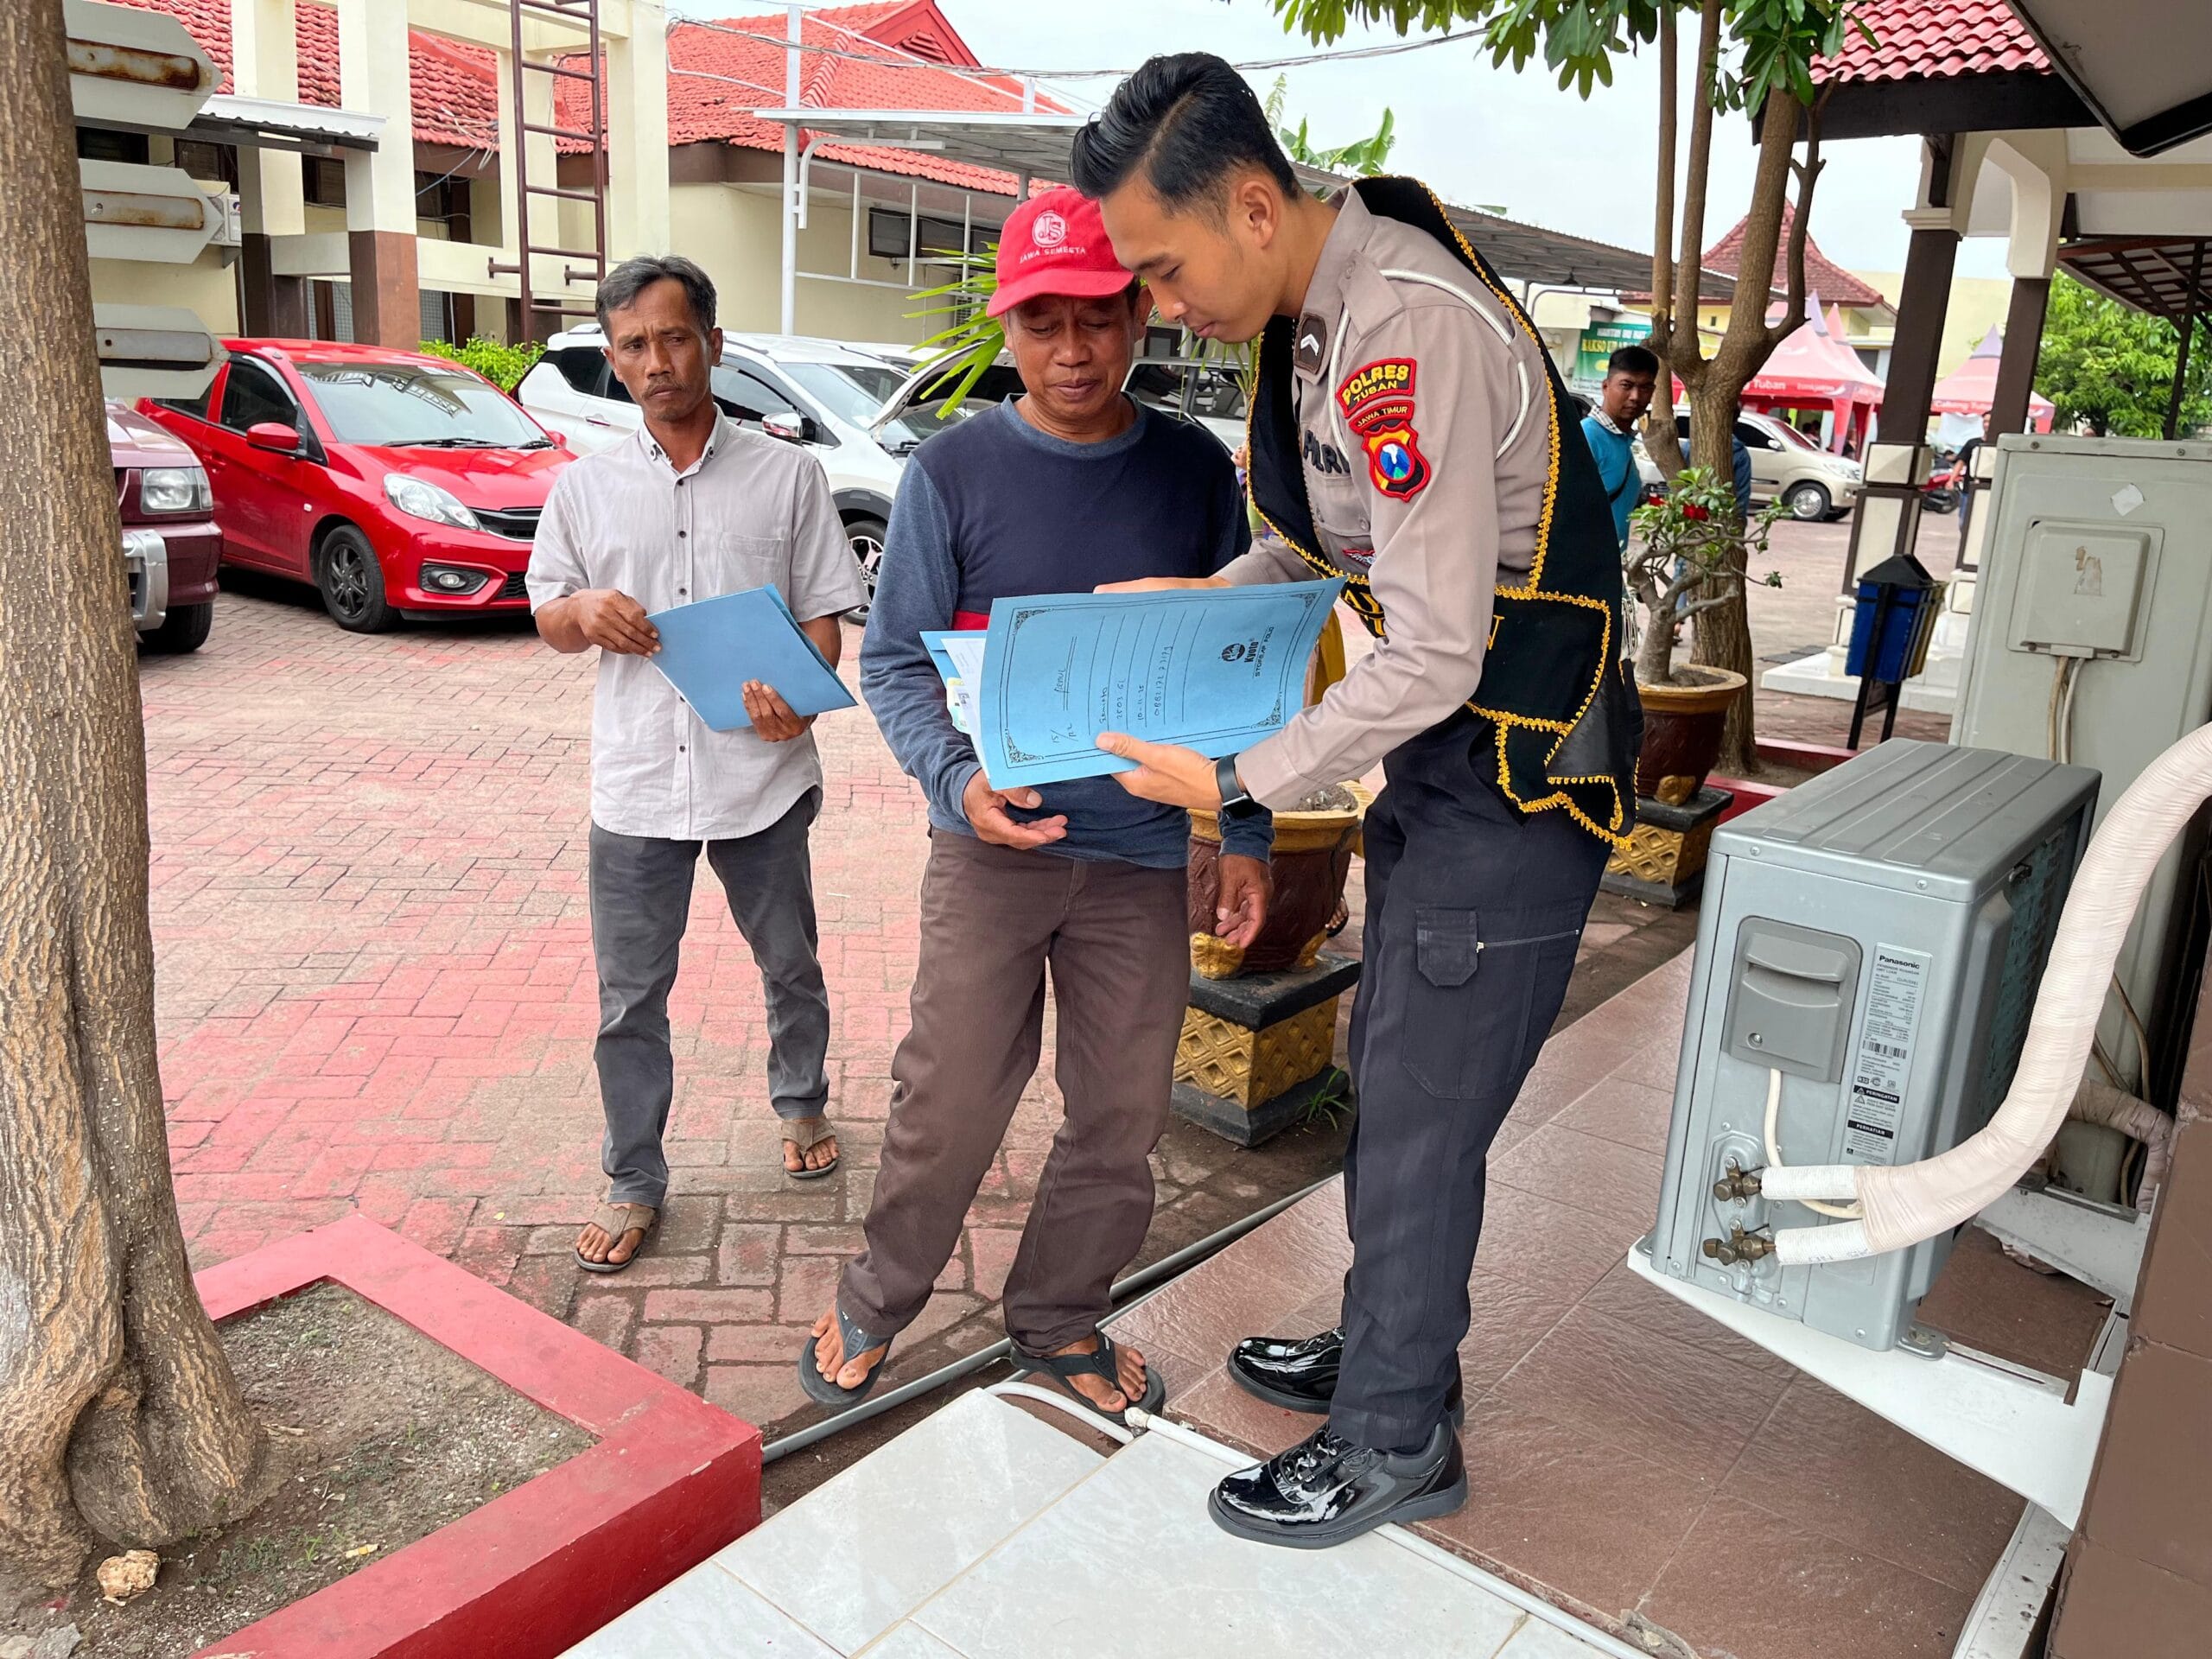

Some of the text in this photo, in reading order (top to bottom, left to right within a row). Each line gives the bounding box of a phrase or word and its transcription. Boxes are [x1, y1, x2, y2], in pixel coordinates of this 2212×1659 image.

[1039, 215, 1062, 240] JS
[1020, 246, 1086, 264] JAWA SEMESTA
[1342, 364, 1409, 406] POLRES
[1353, 380, 1397, 402] TUBAN
[1753, 378, 1786, 391] Tuban
[1357, 406, 1408, 427] JAWA TIMUR
[1263, 626, 1275, 643] FOLIO
[1243, 641, 1259, 663] Kyoto
[1879, 955, 1920, 969] Panasonic
[1866, 1090, 1898, 1102] PERINGATAN
[1856, 1124, 1885, 1135] PERHATIAN
